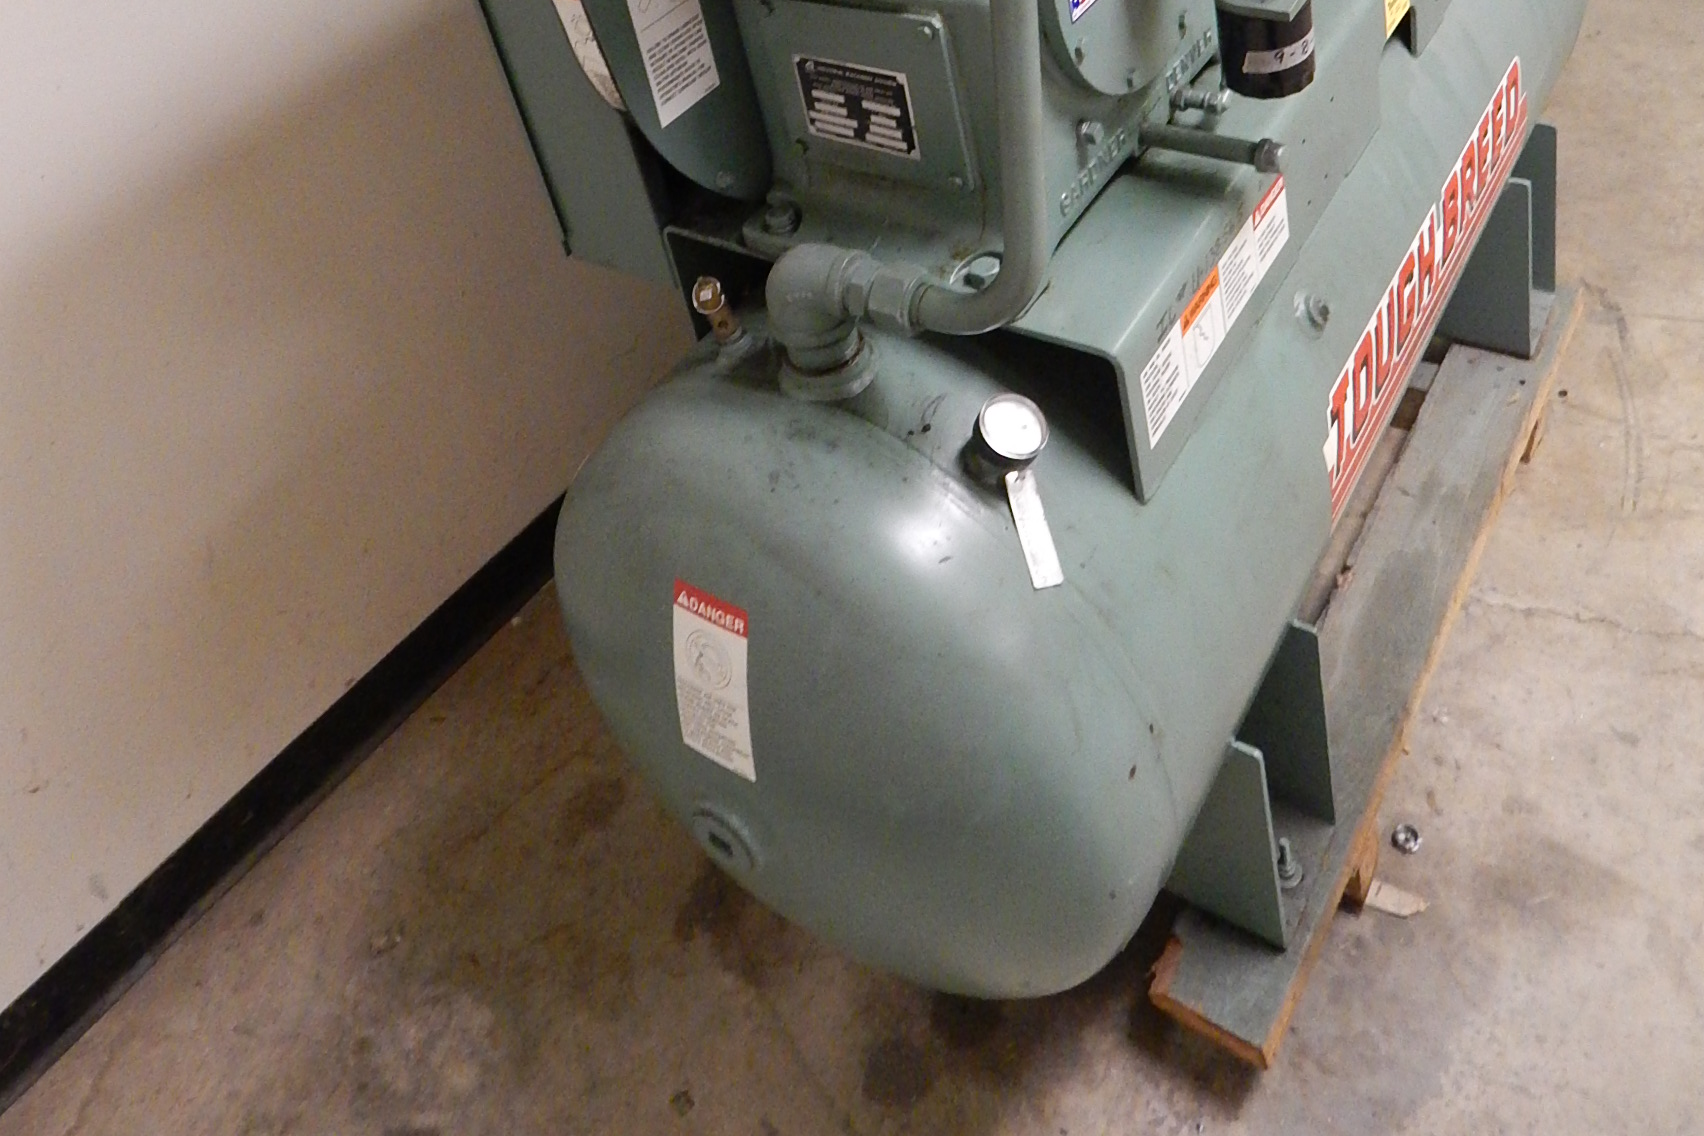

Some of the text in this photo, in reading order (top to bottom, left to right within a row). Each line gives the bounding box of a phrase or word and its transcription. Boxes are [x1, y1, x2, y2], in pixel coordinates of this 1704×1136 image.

[1330, 60, 1521, 486] TOUGH BREED
[689, 596, 745, 635] DANGER
